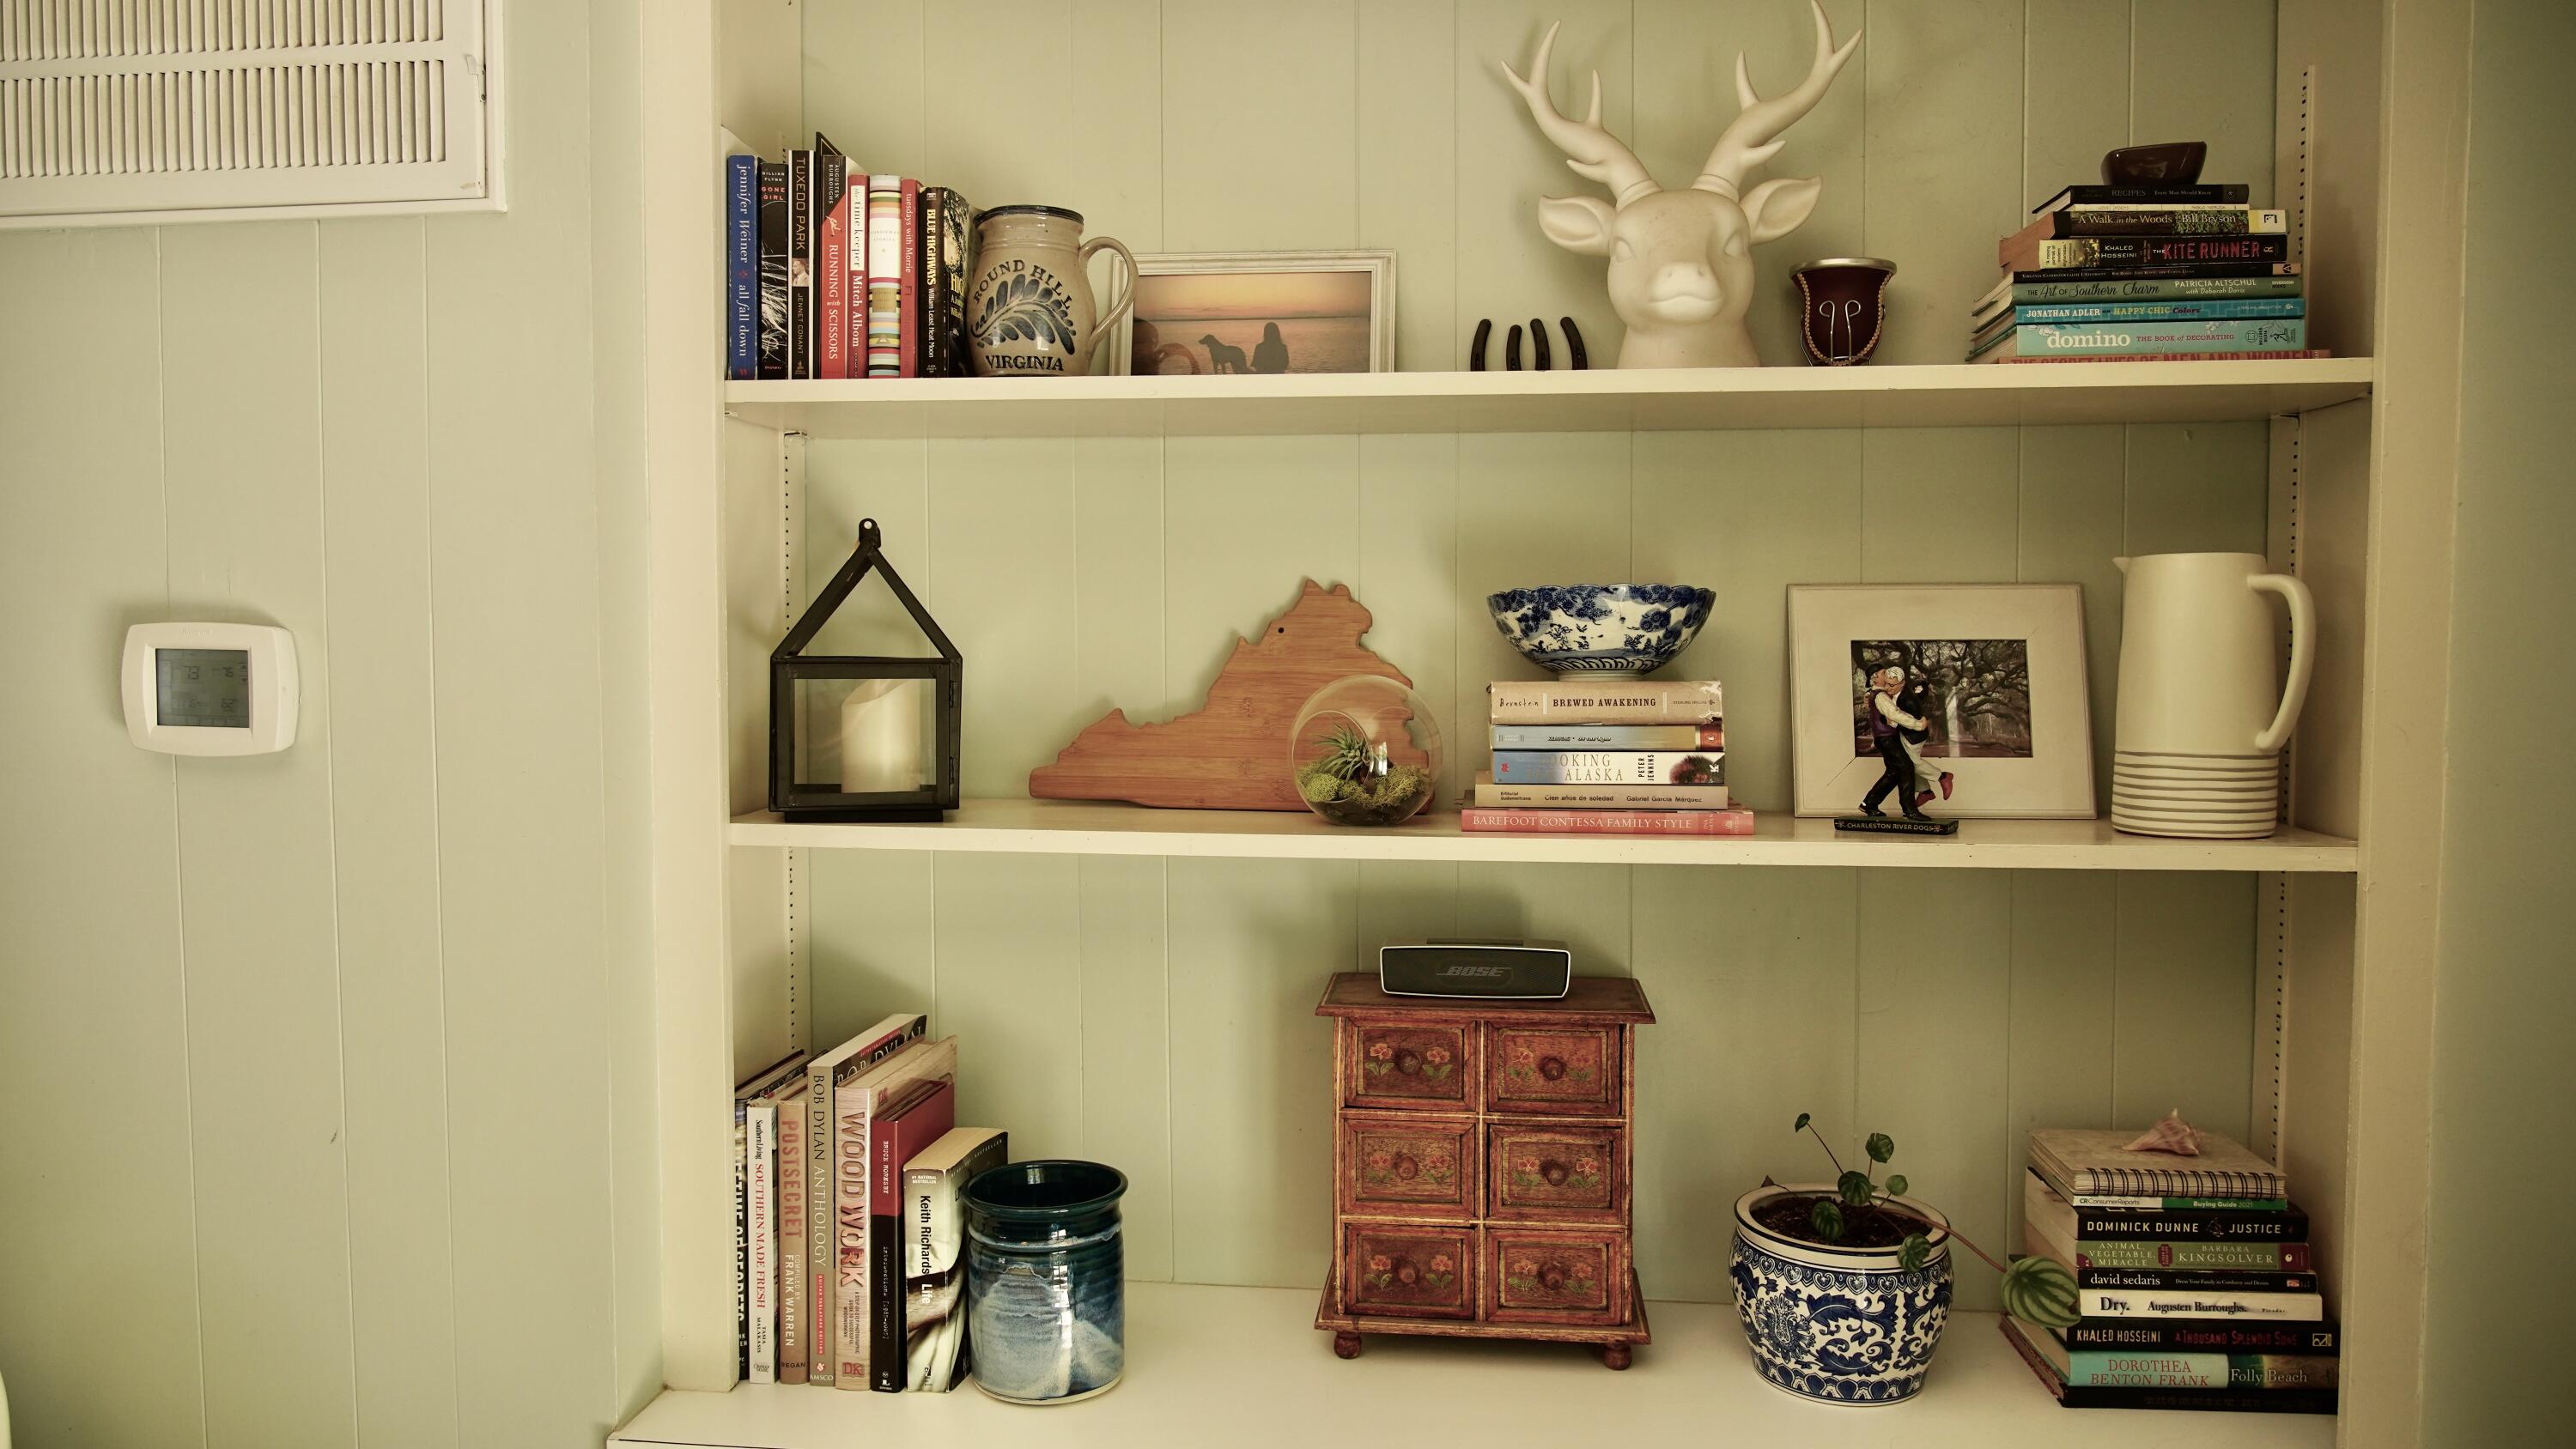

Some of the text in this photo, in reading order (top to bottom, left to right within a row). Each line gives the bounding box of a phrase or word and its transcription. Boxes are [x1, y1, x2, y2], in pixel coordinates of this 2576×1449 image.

[796, 157, 805, 250] TUXEDO PARK
[737, 164, 751, 263] jennifer Weiner
[2089, 215, 2113, 224] Walk
[2141, 214, 2172, 223] Woods
[2181, 214, 2197, 223] Bill
[2202, 214, 2236, 226] Bryson
[927, 209, 936, 285] BLUE HIGHWAYS
[2163, 243, 2196, 259] KITE
[2199, 241, 2260, 259] RUNNER
[829, 245, 839, 298] RUNNING
[974, 259, 1025, 304] ROUND
[1030, 264, 1072, 309] HILL
[2039, 284, 2057, 300] Art
[2069, 283, 2117, 298] Southern
[2123, 282, 2160, 296] Charm
[736, 284, 750, 356] all fall down
[852, 276, 863, 347] Mitch Albom
[2026, 309, 2070, 318] JONATHAN
[2072, 308, 2101, 317] ADLER
[829, 309, 838, 359] SCISSORS
[2047, 330, 2130, 348] domino
[986, 355, 1064, 372] VIRGINIA
[1499, 698, 1656, 707] Bernstein BREWED AWAKENING
[1565, 769, 1623, 781] ALASKA
[1473, 816, 1692, 828] BAREFOOT CONTESSA FAMILY STYLE
[1437, 966, 1511, 977] BOSE
[782, 1120, 802, 1237] POSTSECRET
[813, 1075, 826, 1266] BOB DYLAN ANTHOLOGY
[755, 1119, 765, 1308] Southern Living SOUTHERN MADE FRESH
[2087, 1222, 2281, 1234] DOMINICK DUNNE JUSTICE
[920, 1196, 933, 1304] Keith Richards Life
[2089, 1250, 2156, 1258] VEGETABLE,
[2179, 1253, 2274, 1264] KINGSOLVER
[2090, 1273, 2120, 1284] david
[2123, 1275, 2160, 1285] sedaris
[785, 1254, 794, 1346] FRANK WARREN
[2100, 1297, 2247, 1314] Dry. Augusten Burroughs.
[2076, 1330, 2114, 1342] KHALED
[2117, 1331, 2160, 1343] HOSSEINI
[842, 1363, 865, 1376] DK
[2108, 1360, 2191, 1373] DOROTHEA
[2091, 1373, 2209, 1386] BENTON FRANK
[2231, 1368, 2308, 1385] Folly Beach
